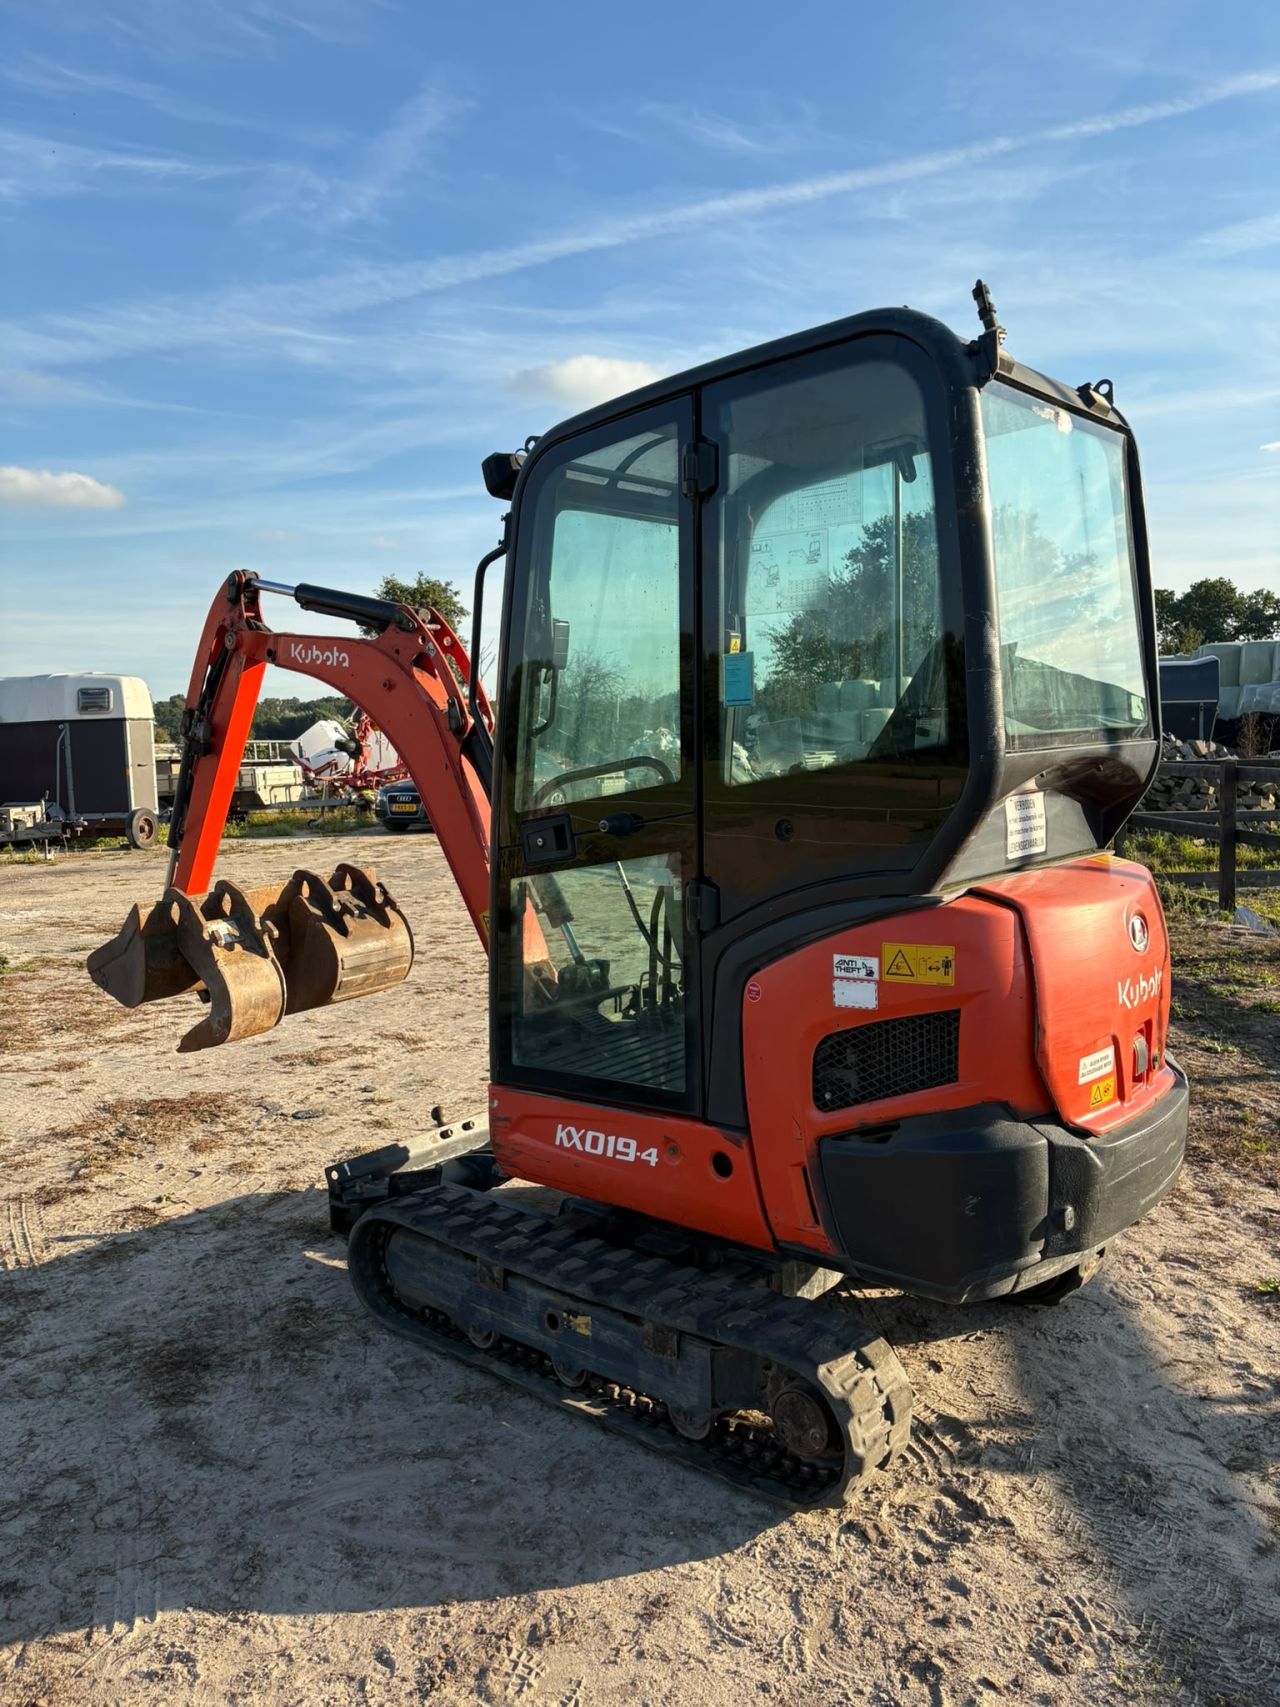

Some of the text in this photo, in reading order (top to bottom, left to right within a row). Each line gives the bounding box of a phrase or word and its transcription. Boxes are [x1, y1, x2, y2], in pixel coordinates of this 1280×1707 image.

[291, 643, 350, 668] Kubota
[834, 965, 862, 974] THEFT
[554, 1123, 660, 1168] KX019-4
